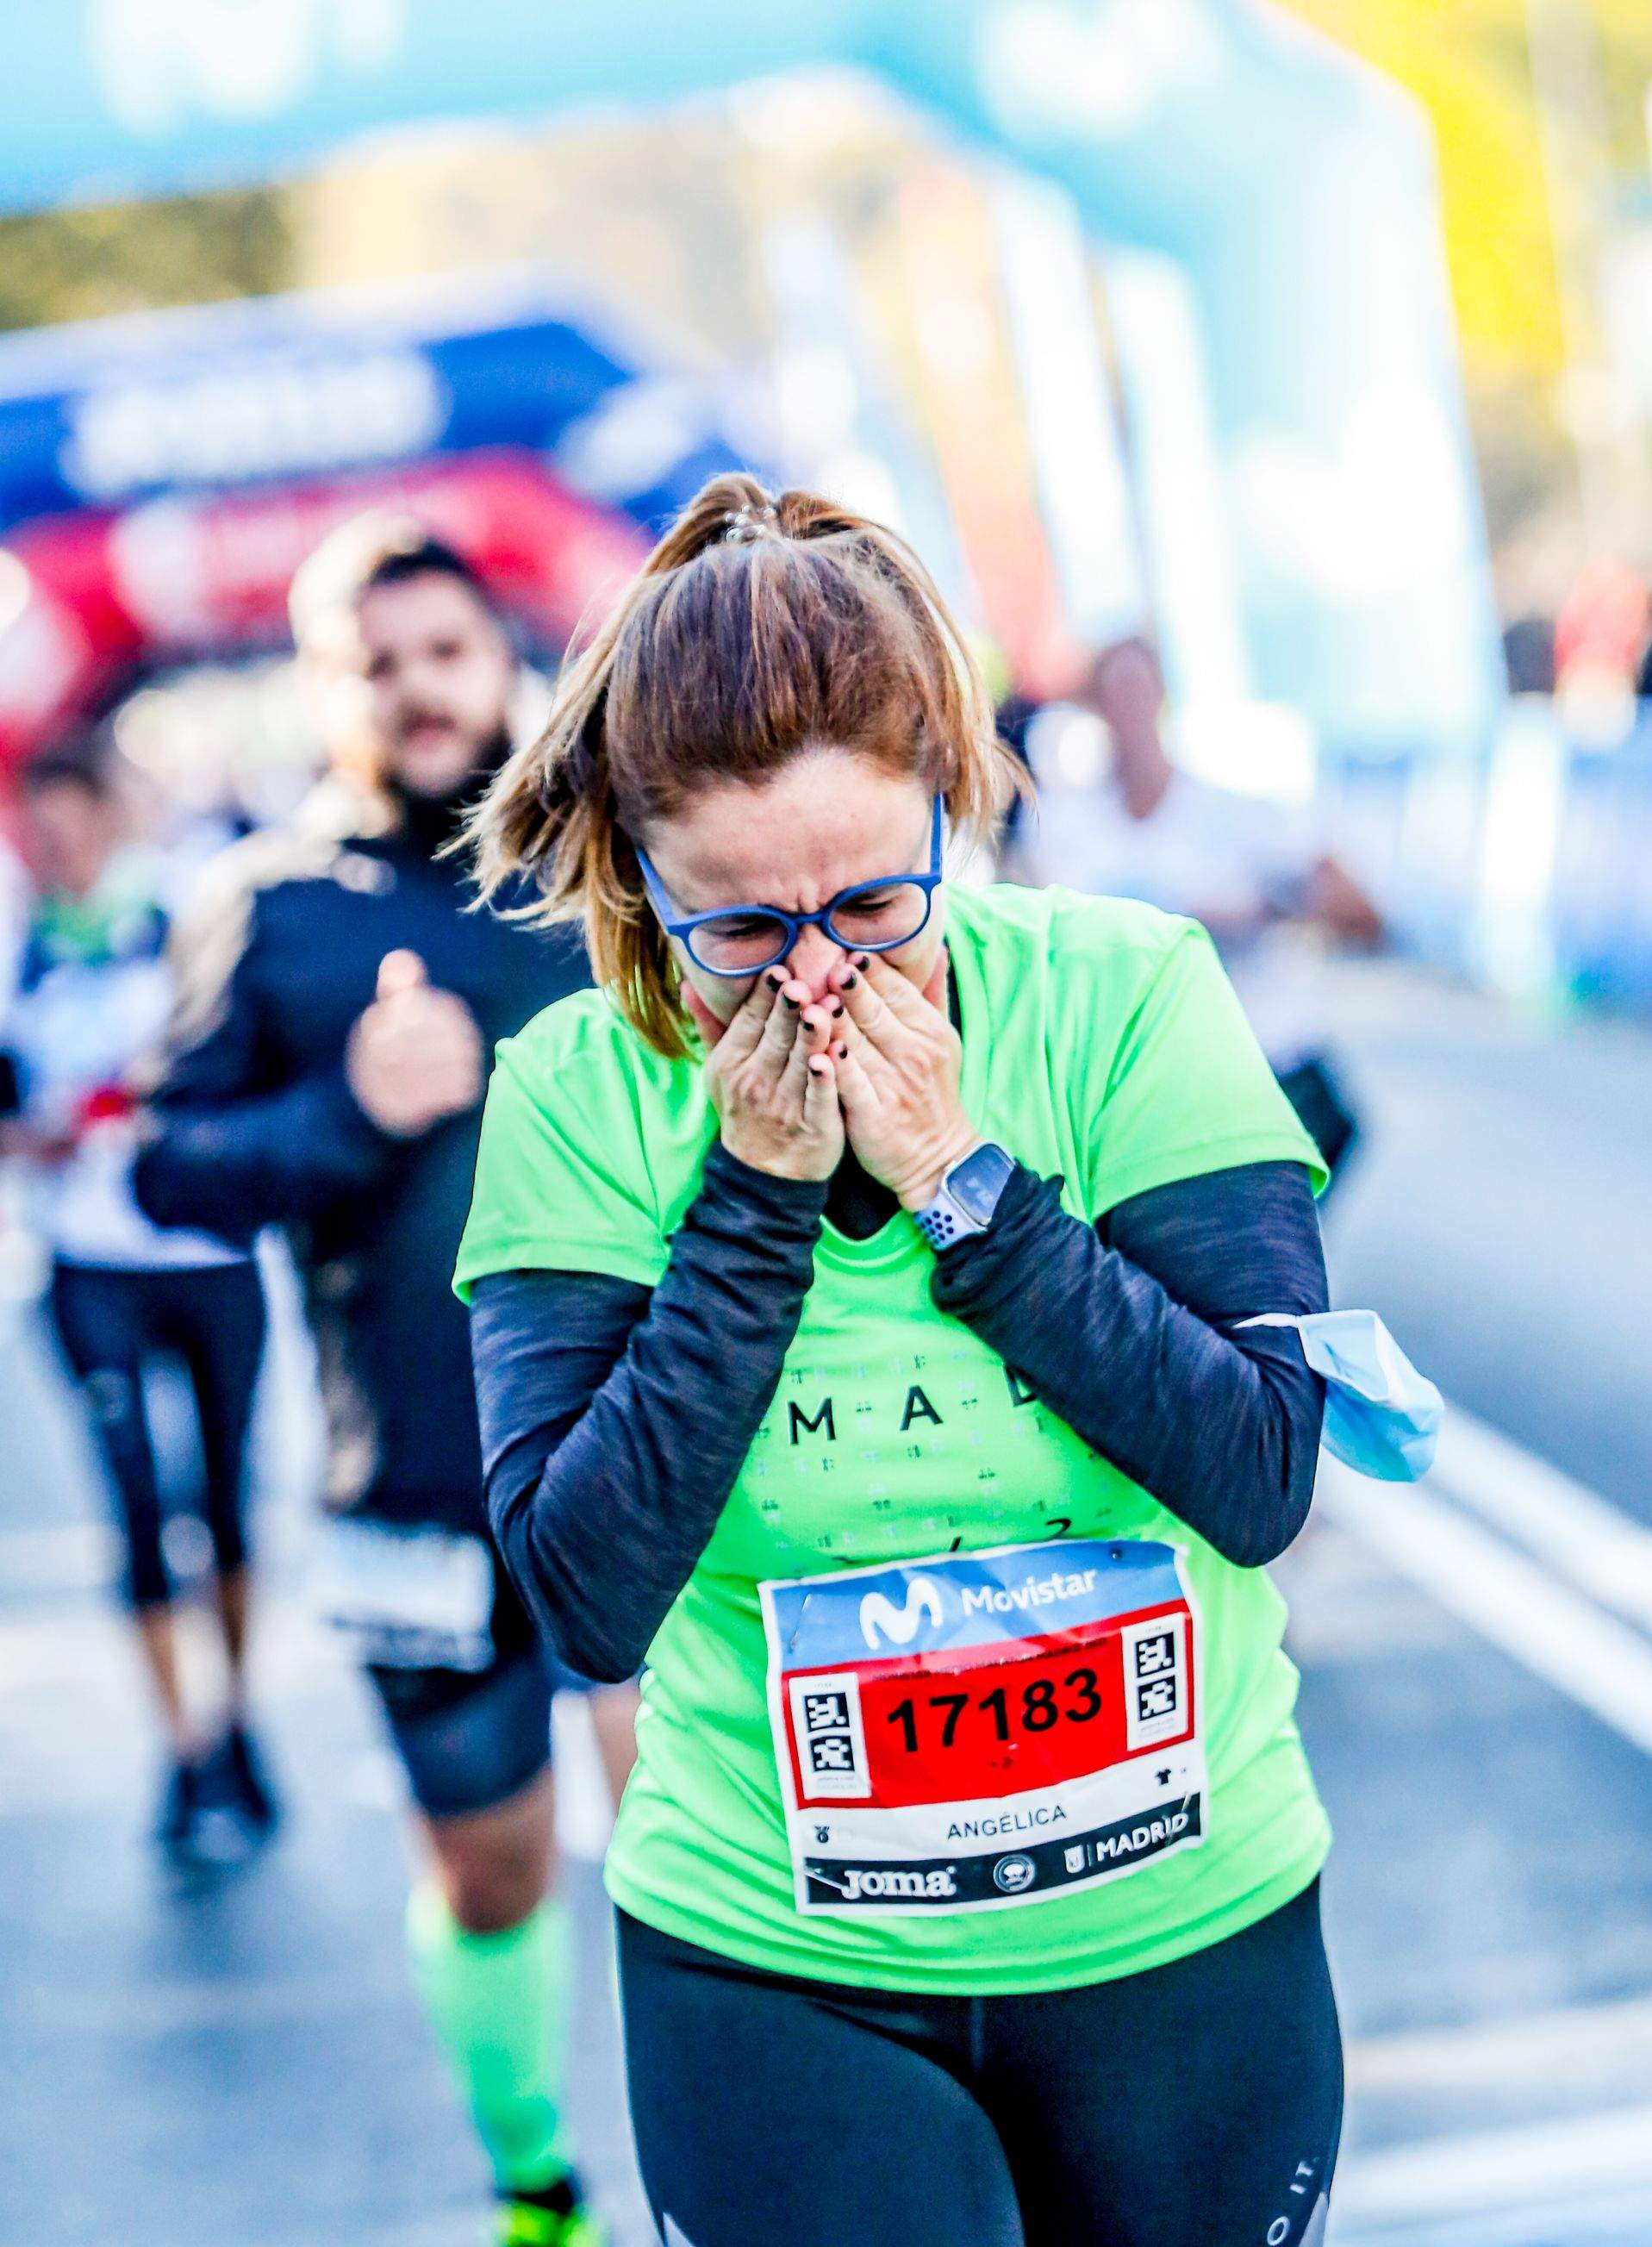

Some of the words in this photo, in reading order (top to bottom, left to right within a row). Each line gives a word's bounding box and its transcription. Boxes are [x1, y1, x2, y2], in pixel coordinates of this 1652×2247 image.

[961, 1569, 1097, 1616] Movistar
[887, 1669, 1102, 1752] 17183
[947, 1804, 1067, 1839] ANGÉLICA
[1096, 1813, 1188, 1862] MADRID
